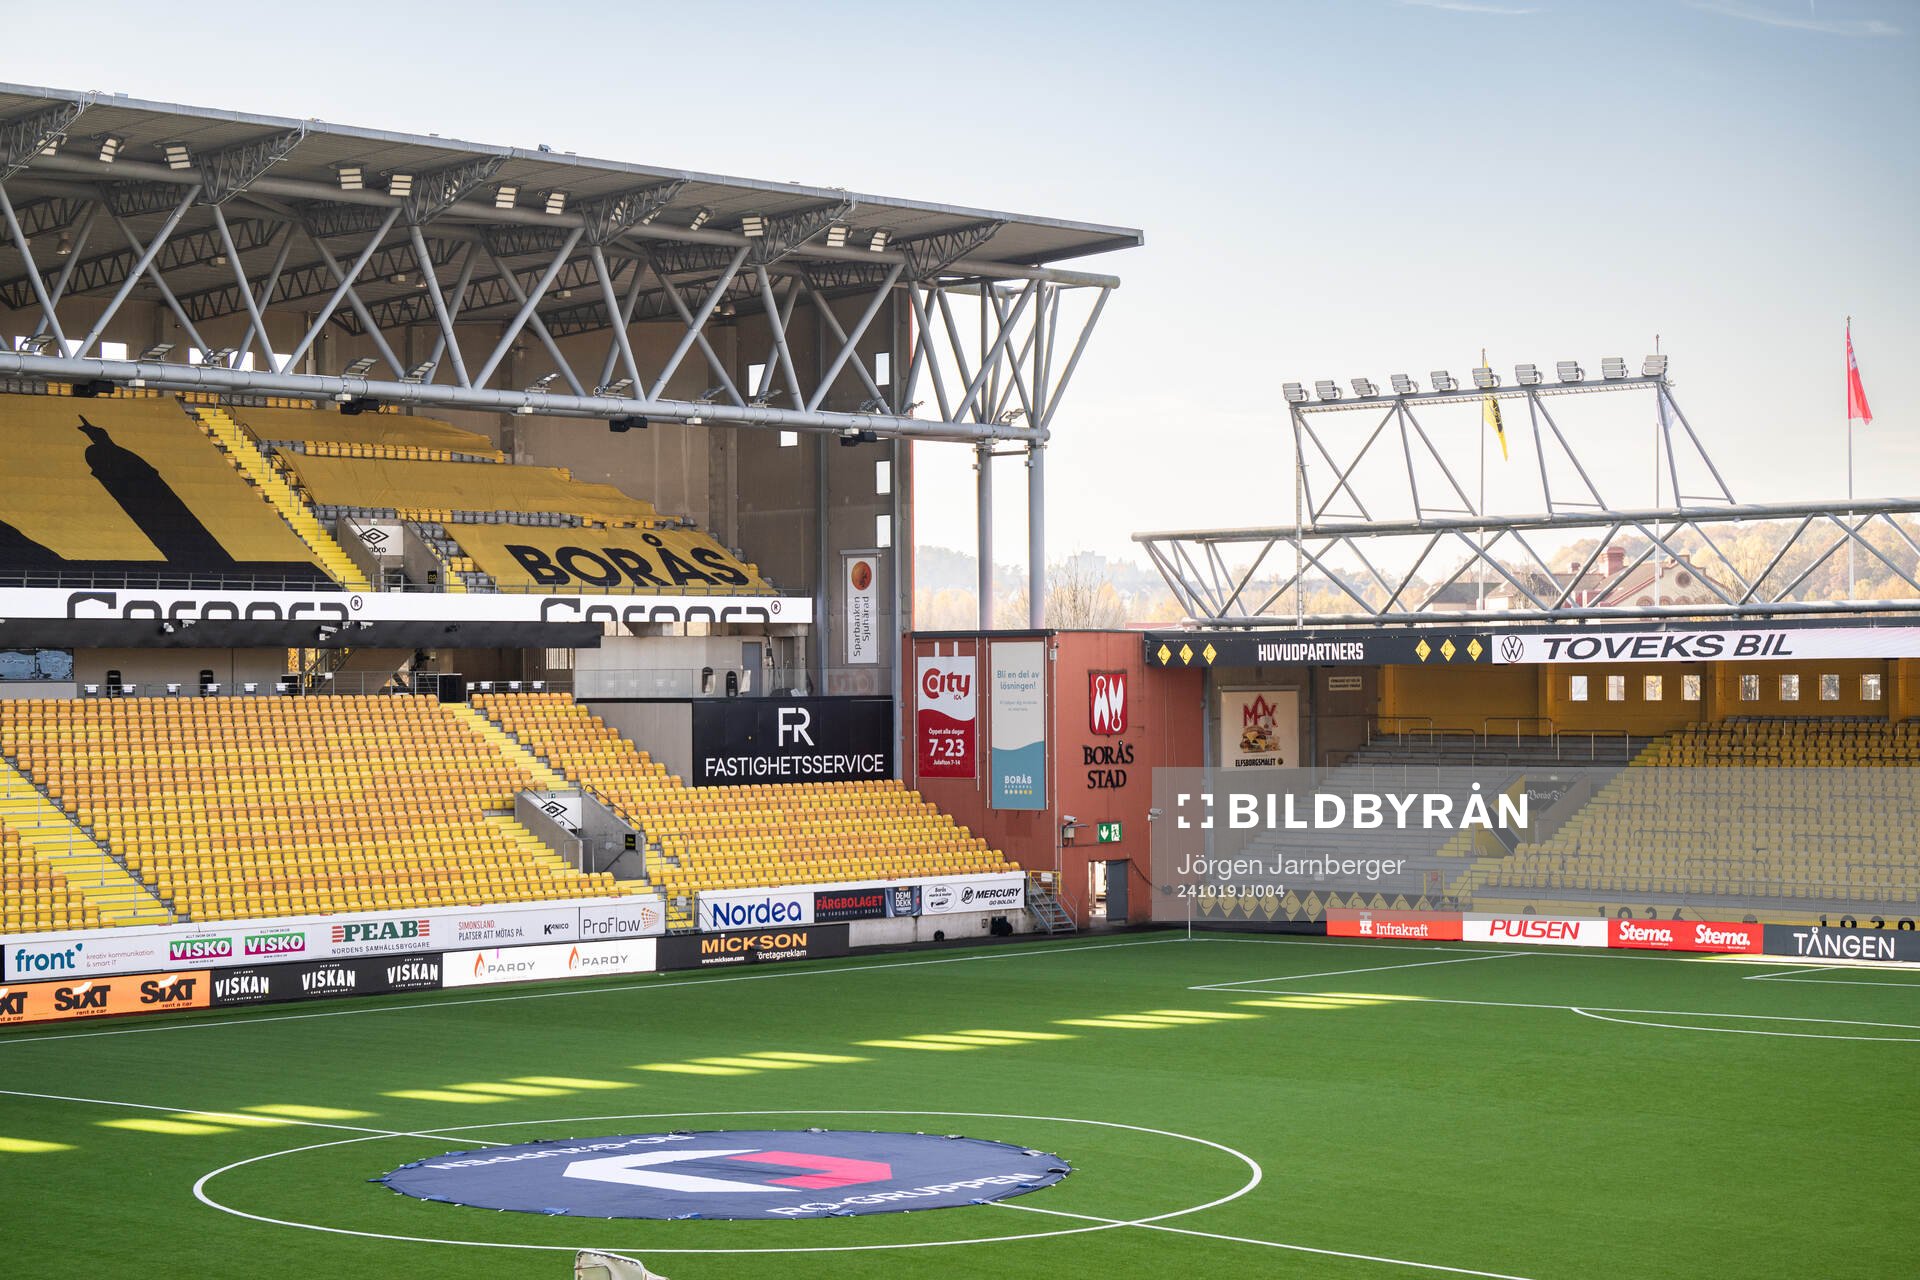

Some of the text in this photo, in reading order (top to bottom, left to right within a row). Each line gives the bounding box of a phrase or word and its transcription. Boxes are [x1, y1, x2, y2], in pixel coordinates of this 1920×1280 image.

[505, 534, 749, 587] BORÅS
[853, 596, 862, 657] Sparbanken
[862, 596, 871, 641] Sjuhärad
[1258, 642, 1364, 662] HUVUDPARTNERS
[1543, 634, 1725, 660] TOVEKS
[1733, 633, 1794, 657] BIL
[997, 670, 1006, 678] Bli
[1018, 670, 1030, 678] del
[1000, 681, 1036, 692] lösningen!
[777, 707, 815, 747] FR
[928, 727, 942, 735] Öppet
[928, 739, 965, 757] 7-23
[1083, 741, 1134, 766] BORÅS
[705, 753, 884, 777] FASTIGHETSSERVICE
[1004, 774, 1032, 784] BORÅS
[1087, 769, 1127, 789] STAD
[816, 895, 884, 911] FÄRGBOLAGET
[975, 888, 1021, 899] MERCURY
[713, 897, 802, 928] Nordea
[342, 920, 419, 943] PEAB
[458, 920, 495, 929] SIMONSLAND
[458, 931, 482, 941] PLATSER
[483, 930, 494, 939] ATT
[495, 928, 514, 938] MÖTAS
[583, 917, 641, 935] ProFlow
[1376, 922, 1428, 937] Infrakraft
[1489, 919, 1580, 940] PULSEN
[171, 940, 231, 958] VISKO
[246, 935, 304, 953] VISKO
[332, 941, 430, 954] NORDENS SAMHÄLLSBYGGARE
[1793, 926, 1895, 959] TÅNGEN
[15, 948, 76, 972] front
[488, 961, 535, 974] PAROY
[582, 954, 629, 967] PAROY
[302, 969, 356, 991] VISKAN
[387, 963, 439, 984] VISKAN
[215, 976, 270, 998] VISKAN
[766, 1172, 1044, 1216] RO-GRUPPEN
